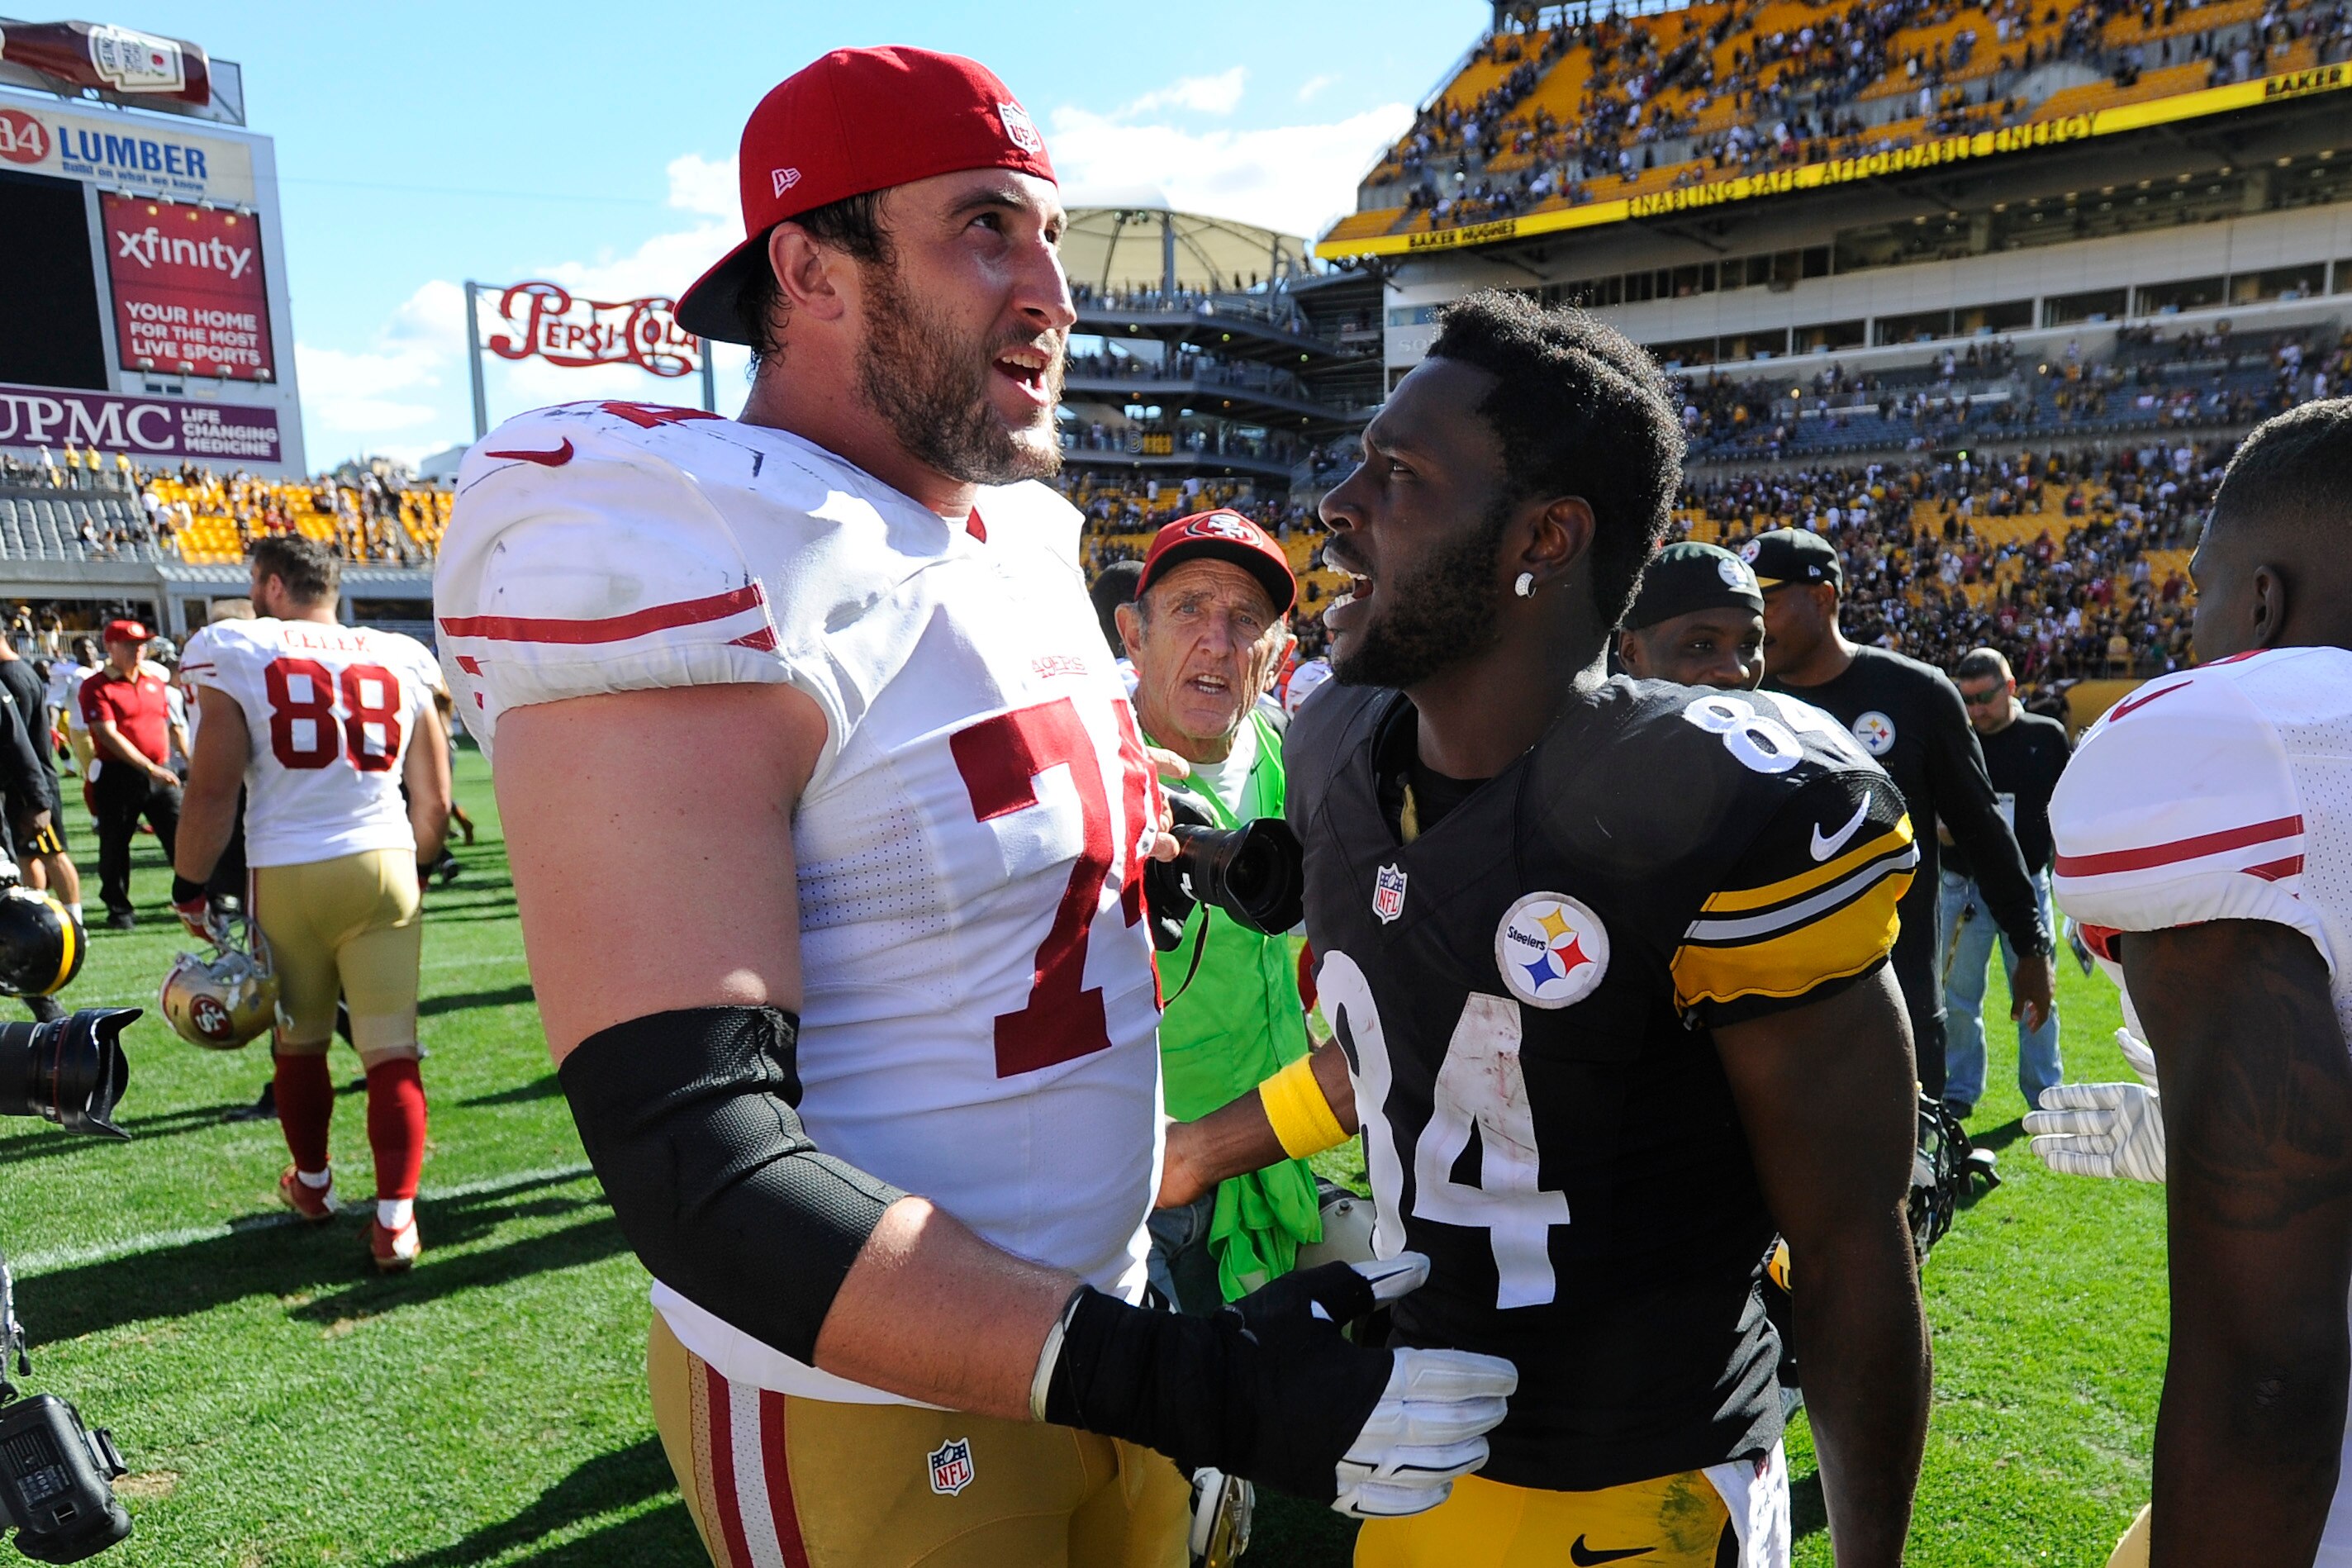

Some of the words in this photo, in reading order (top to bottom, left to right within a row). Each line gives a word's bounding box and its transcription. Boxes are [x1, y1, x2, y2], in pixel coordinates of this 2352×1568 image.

[2265, 69, 2341, 96] BAKER
[59, 127, 207, 178] LUMBER
[98, 167, 114, 177] on
[118, 170, 147, 182] what
[1628, 181, 1733, 218] ENABLING
[1409, 230, 1456, 247] BAKER
[117, 227, 251, 278] xfinity
[125, 301, 188, 324] YOUR
[193, 309, 257, 330] HOME
[130, 321, 169, 340] FOR
[172, 325, 207, 344] THE
[210, 330, 258, 348] MOST
[131, 338, 179, 359] LIVE
[182, 342, 261, 366] SPORTS
[181, 408, 221, 423] LIFE
[182, 421, 278, 444] CHANGING
[184, 437, 272, 456] MEDICINE
[264, 657, 402, 772] 88
[1377, 888, 1399, 914] NFL
[1507, 925, 1547, 952] Steelers
[936, 1461, 968, 1487] NFL
